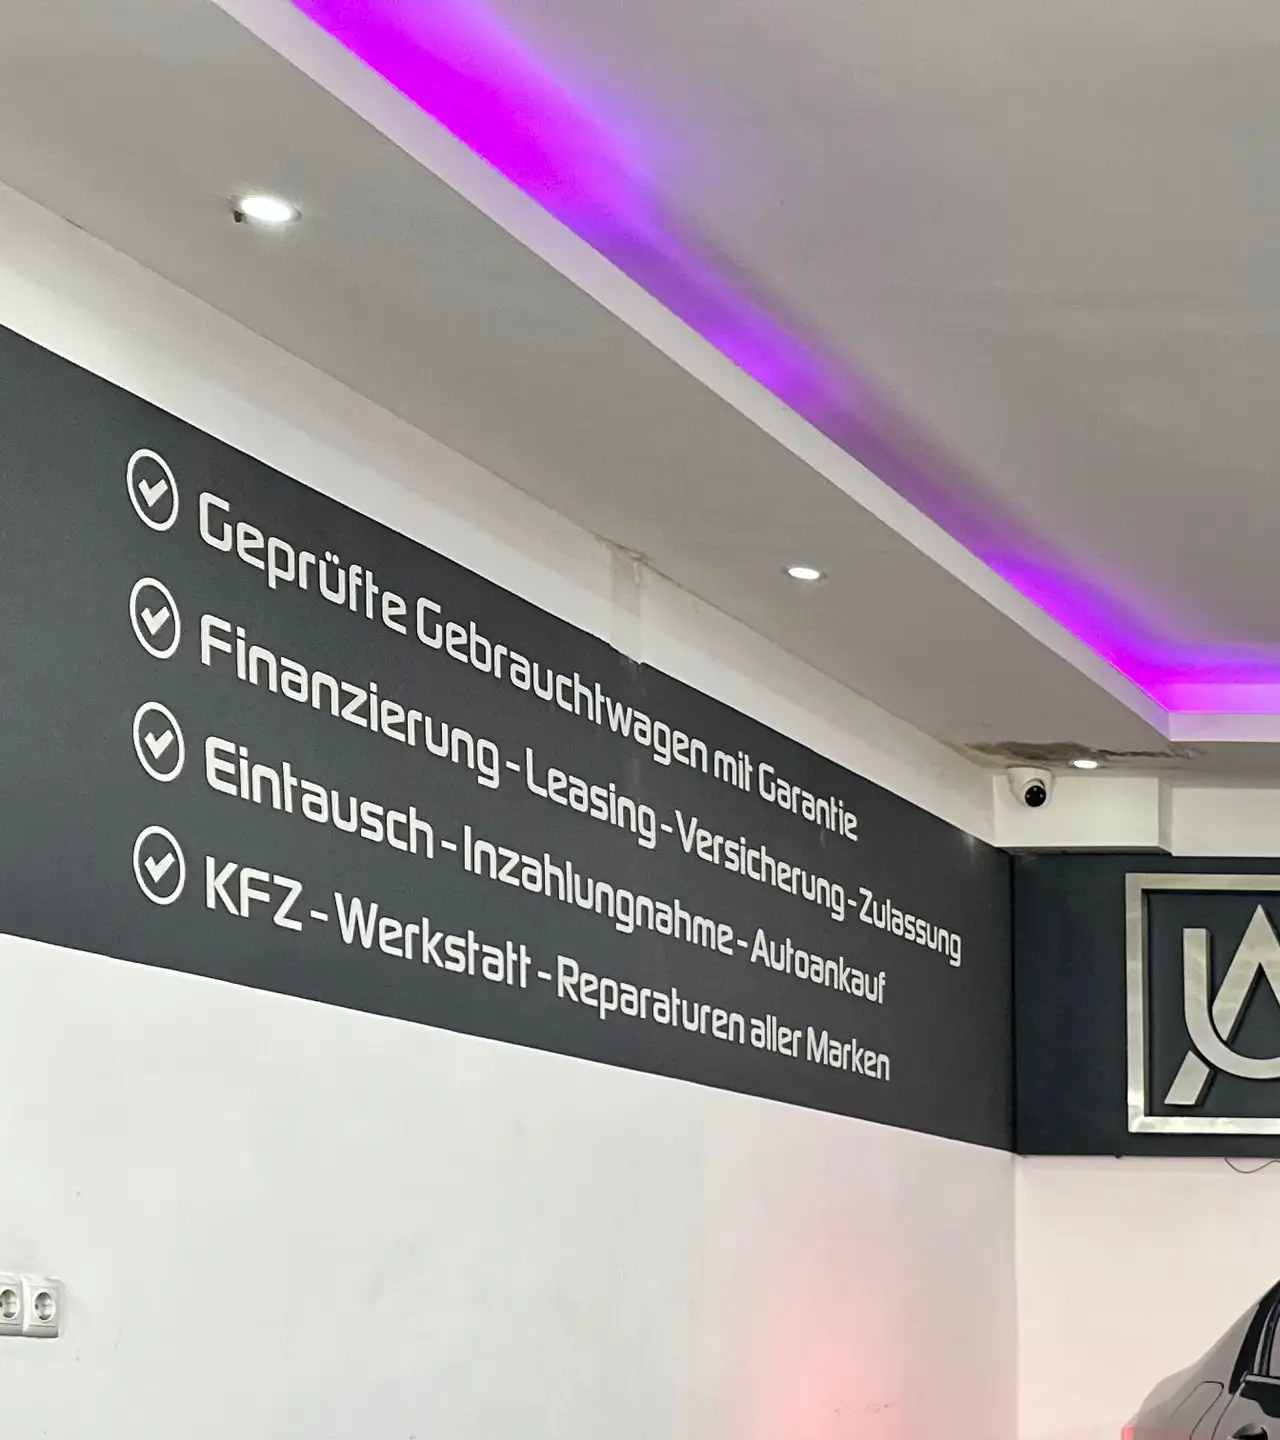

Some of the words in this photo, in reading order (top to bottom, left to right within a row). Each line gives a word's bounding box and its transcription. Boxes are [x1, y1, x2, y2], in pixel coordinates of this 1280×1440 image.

[199, 491, 407, 635] Geprüfte
[416, 596, 708, 773] Gebrauchtwagen
[713, 748, 754, 792] mit
[758, 762, 859, 842] Garantie
[204, 735, 434, 860] Eintausch
[556, 954, 746, 1045] Reparaturen
[750, 1013, 803, 1059] aller
[806, 1026, 891, 1082] Marken
